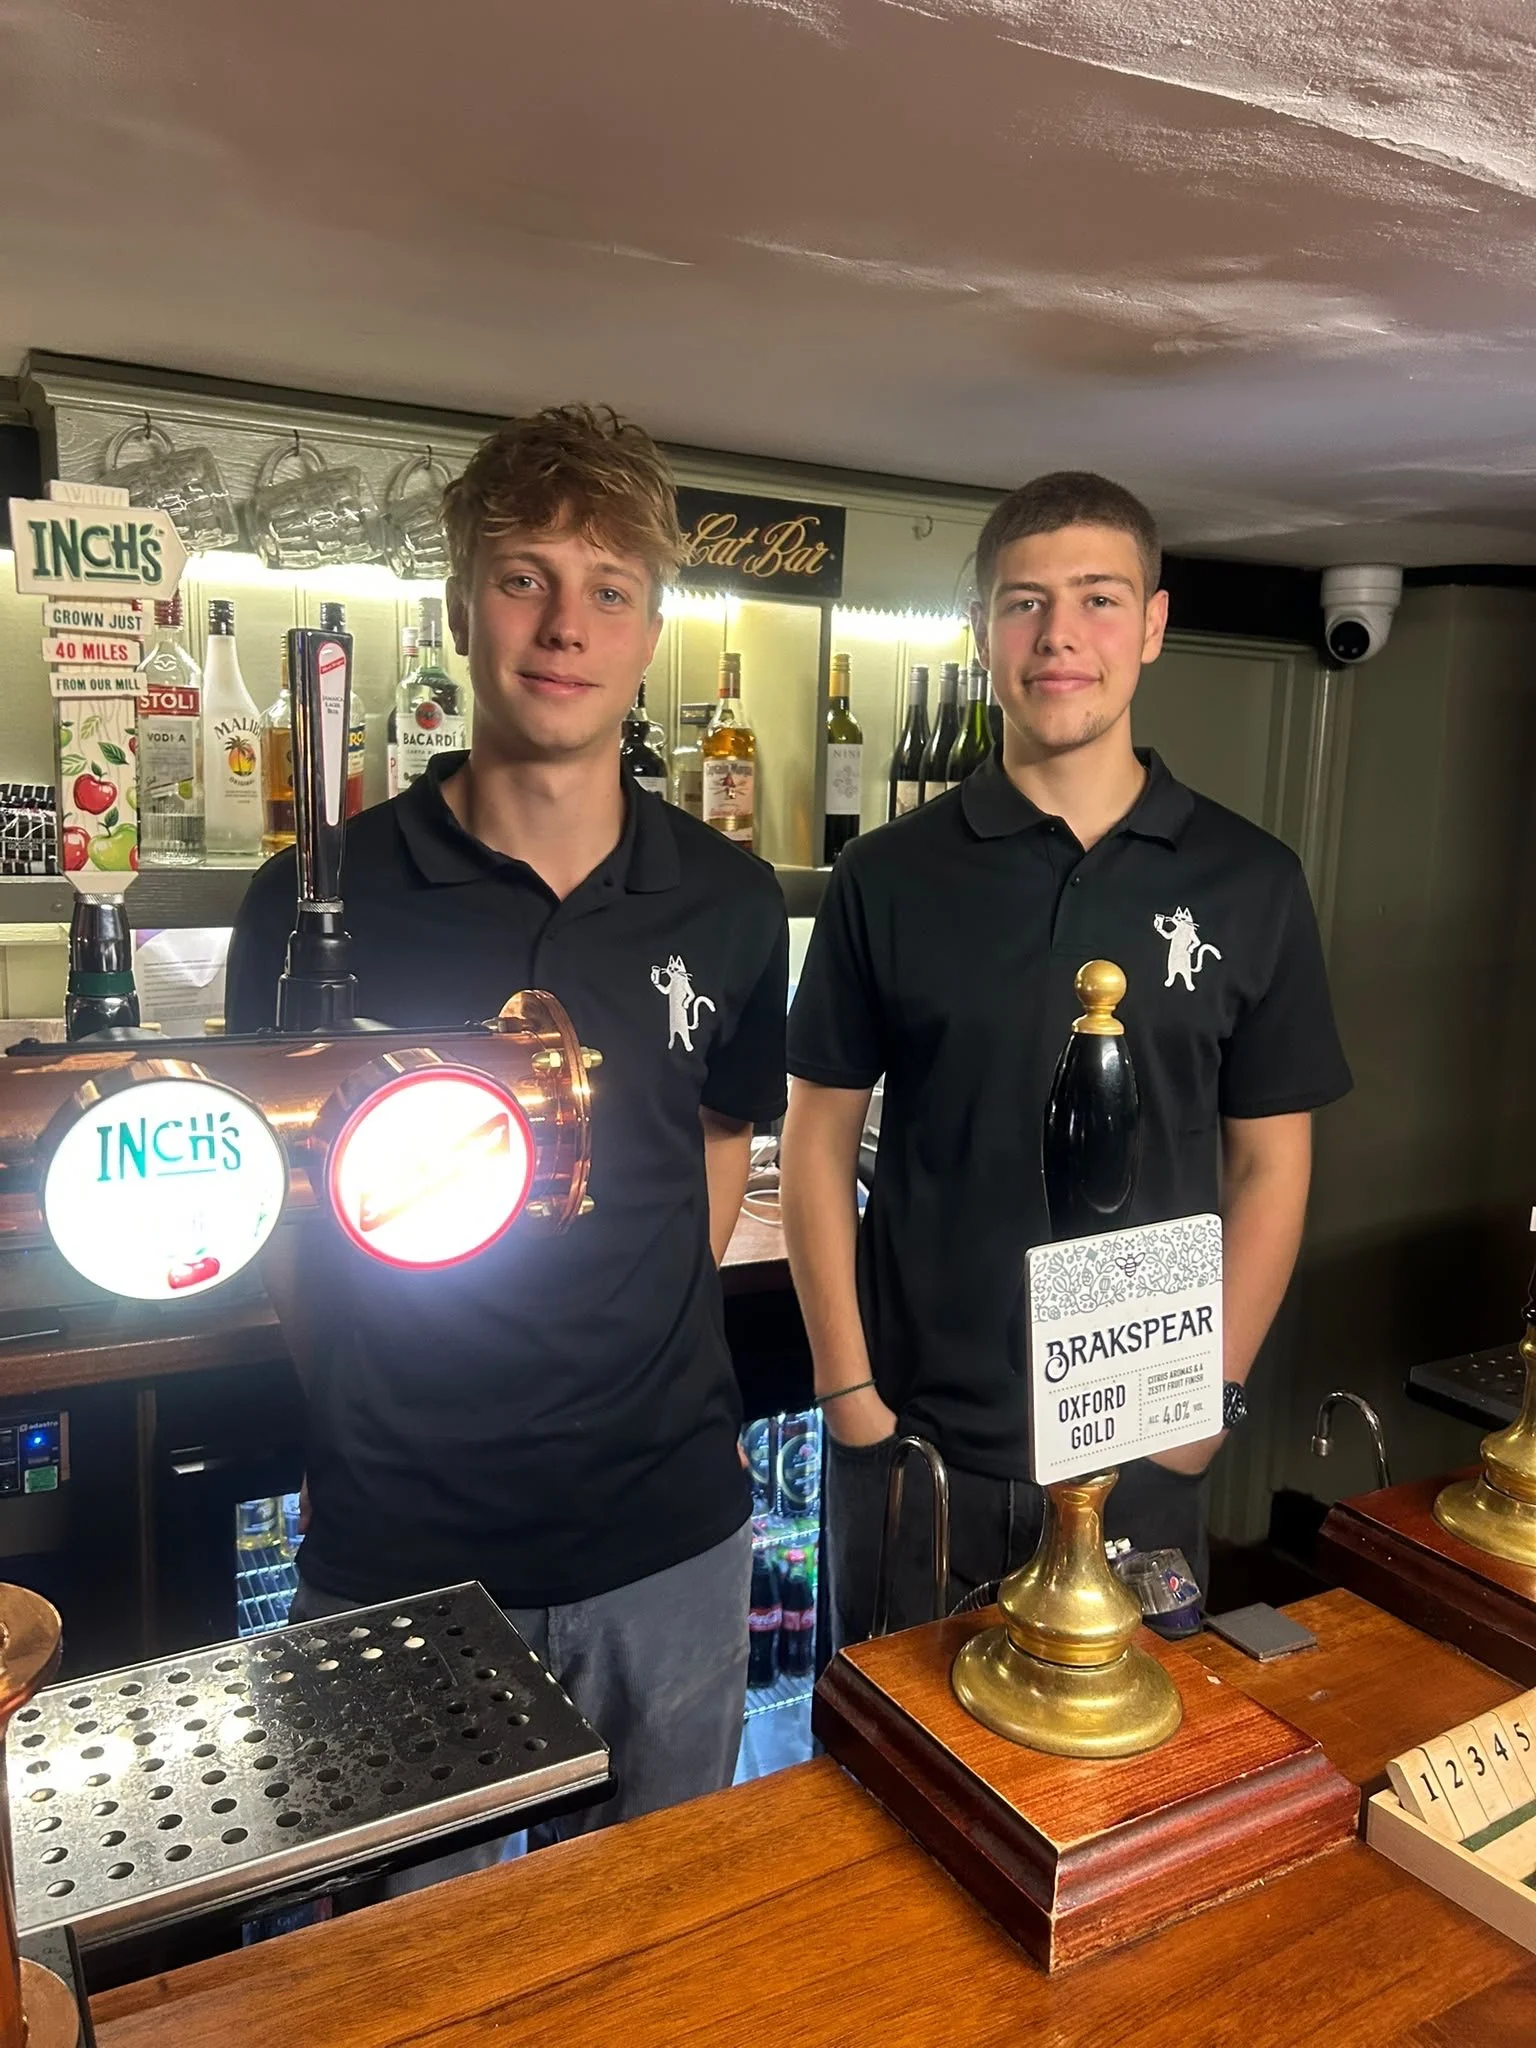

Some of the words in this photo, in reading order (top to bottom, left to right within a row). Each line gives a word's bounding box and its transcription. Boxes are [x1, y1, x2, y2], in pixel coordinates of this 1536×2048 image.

[28, 518, 163, 584] INCH'S
[685, 513, 760, 567] Cat
[743, 515, 829, 578] Bar
[53, 609, 104, 627] GROWN
[109, 614, 142, 631] JUST
[56, 642, 76, 659] 40
[83, 643, 129, 660] MILES
[56, 678, 87, 690] FROM
[90, 679, 112, 690] OUR
[116, 679, 141, 691] MILL
[140, 692, 193, 710] STOLI
[96, 1111, 242, 1183] INCH'S
[1044, 1305, 1214, 1383] BRAKSPEAR
[1147, 1372, 1169, 1385] CITRUS
[1169, 1365, 1193, 1379] AROMAS
[1193, 1364, 1199, 1373] &
[1199, 1363, 1204, 1371] A
[1147, 1383, 1166, 1396] ZESTY
[1167, 1378, 1184, 1391] FRUIT
[1185, 1373, 1204, 1386] FINISH
[1058, 1384, 1126, 1423] OXFORD
[1163, 1399, 1191, 1425] 4.0%
[1071, 1417, 1115, 1450] GOLD
[1419, 1772, 1439, 1802] 1
[1445, 1759, 1464, 1790] 2
[1467, 1745, 1486, 1777] 3
[1493, 1732, 1509, 1762] 4
[1513, 1722, 1531, 1752] 5
